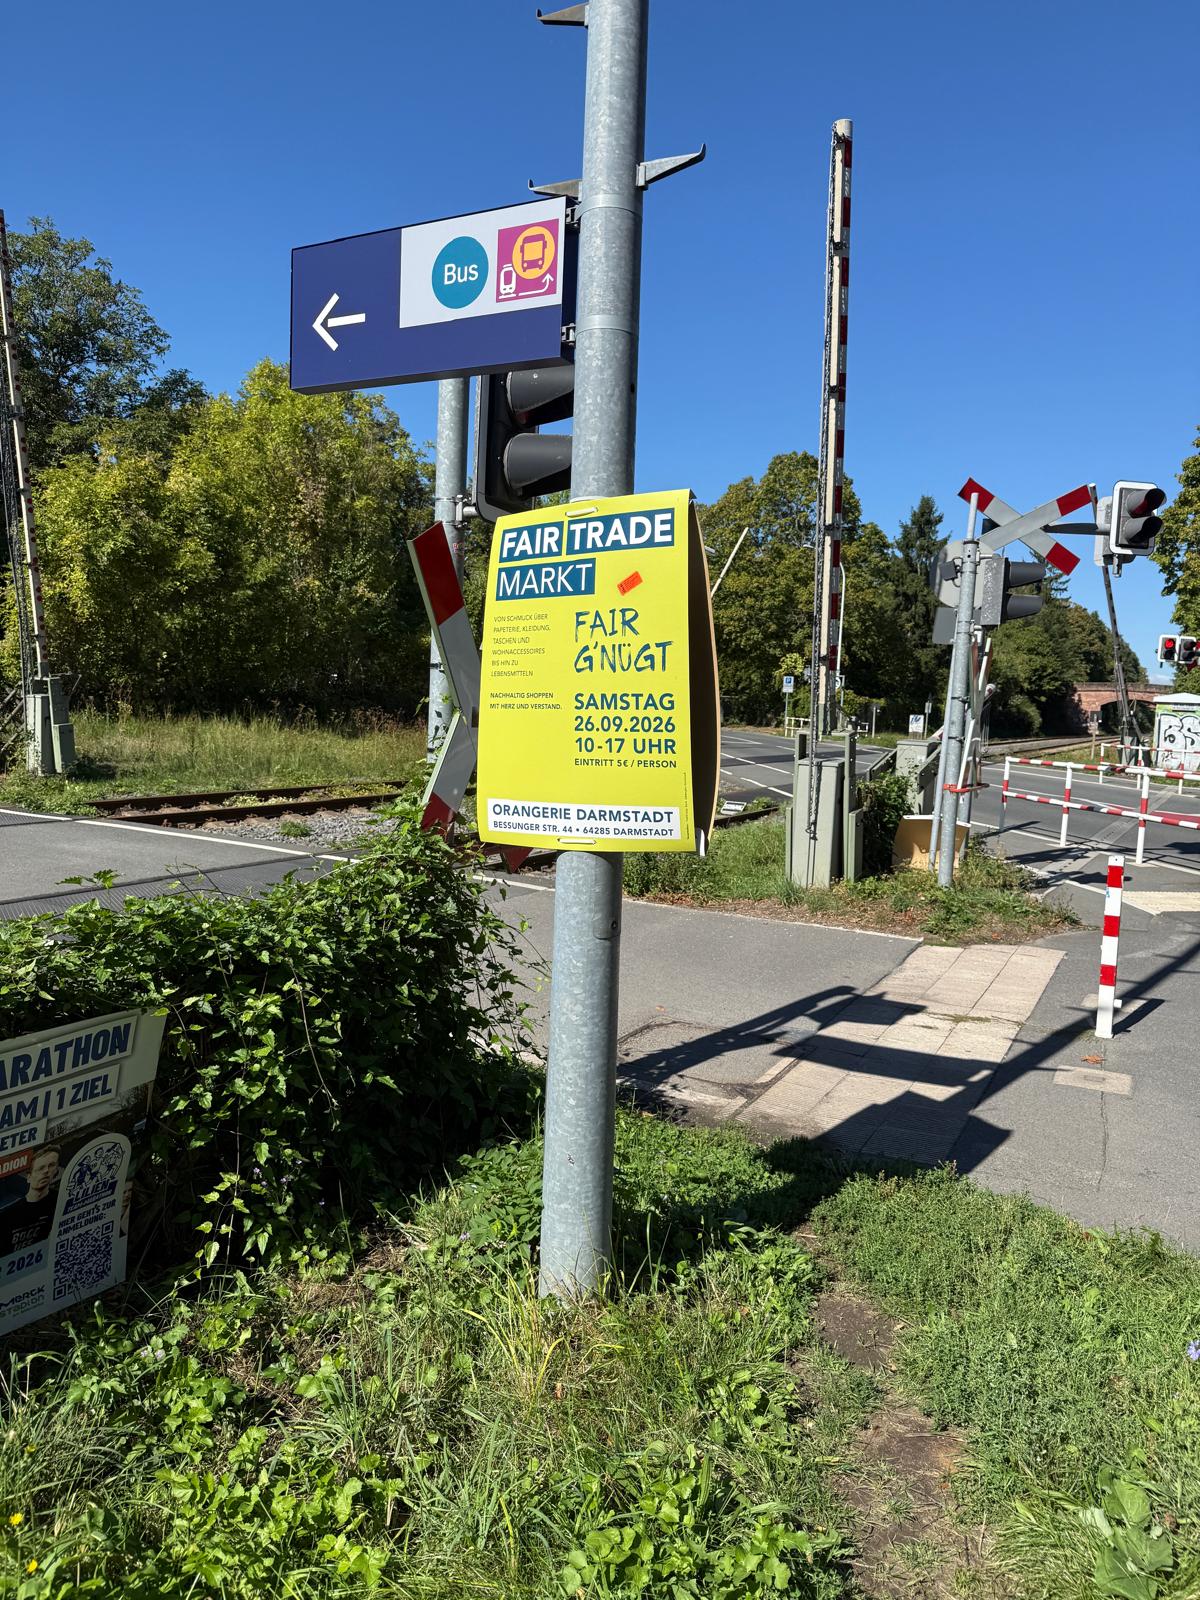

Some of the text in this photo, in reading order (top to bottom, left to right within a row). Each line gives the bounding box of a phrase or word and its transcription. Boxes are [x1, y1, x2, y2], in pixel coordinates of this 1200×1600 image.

[444, 263, 479, 285] Bus
[502, 513, 673, 558] FAIR TRADE
[499, 563, 593, 597] MARKT
[507, 614, 533, 622] SCHMUCK
[533, 612, 548, 620] ÜBER
[575, 608, 639, 643] FAIR
[522, 624, 551, 632] KLEIDUNG,
[493, 637, 517, 645] TASCHEN
[574, 641, 674, 673] G'NÜGT
[574, 692, 675, 711] SAMSTAG
[574, 716, 676, 733] 26.09.2026
[633, 738, 677, 755] UHR
[574, 758, 614, 767] EINTRITT
[616, 759, 629, 768] 5€
[637, 760, 677, 769] PERSON
[492, 804, 674, 823] ORANGERIE DARMSTADT
[493, 820, 540, 832] BESSUNGER
[542, 824, 560, 833] STR.
[562, 825, 573, 834] 44
[582, 826, 611, 835] 64285
[613, 827, 674, 837] DARMSTADT
[56, 1087, 67, 1110] 1
[69, 1074, 112, 1107] ZIEL
[59, 1216, 76, 1229] HIER
[77, 1203, 101, 1221] GEHT'S
[102, 1199, 117, 1212] ZUR
[57, 1212, 107, 1238] ANMELDUNG:
[6, 1248, 43, 1276] 2026
